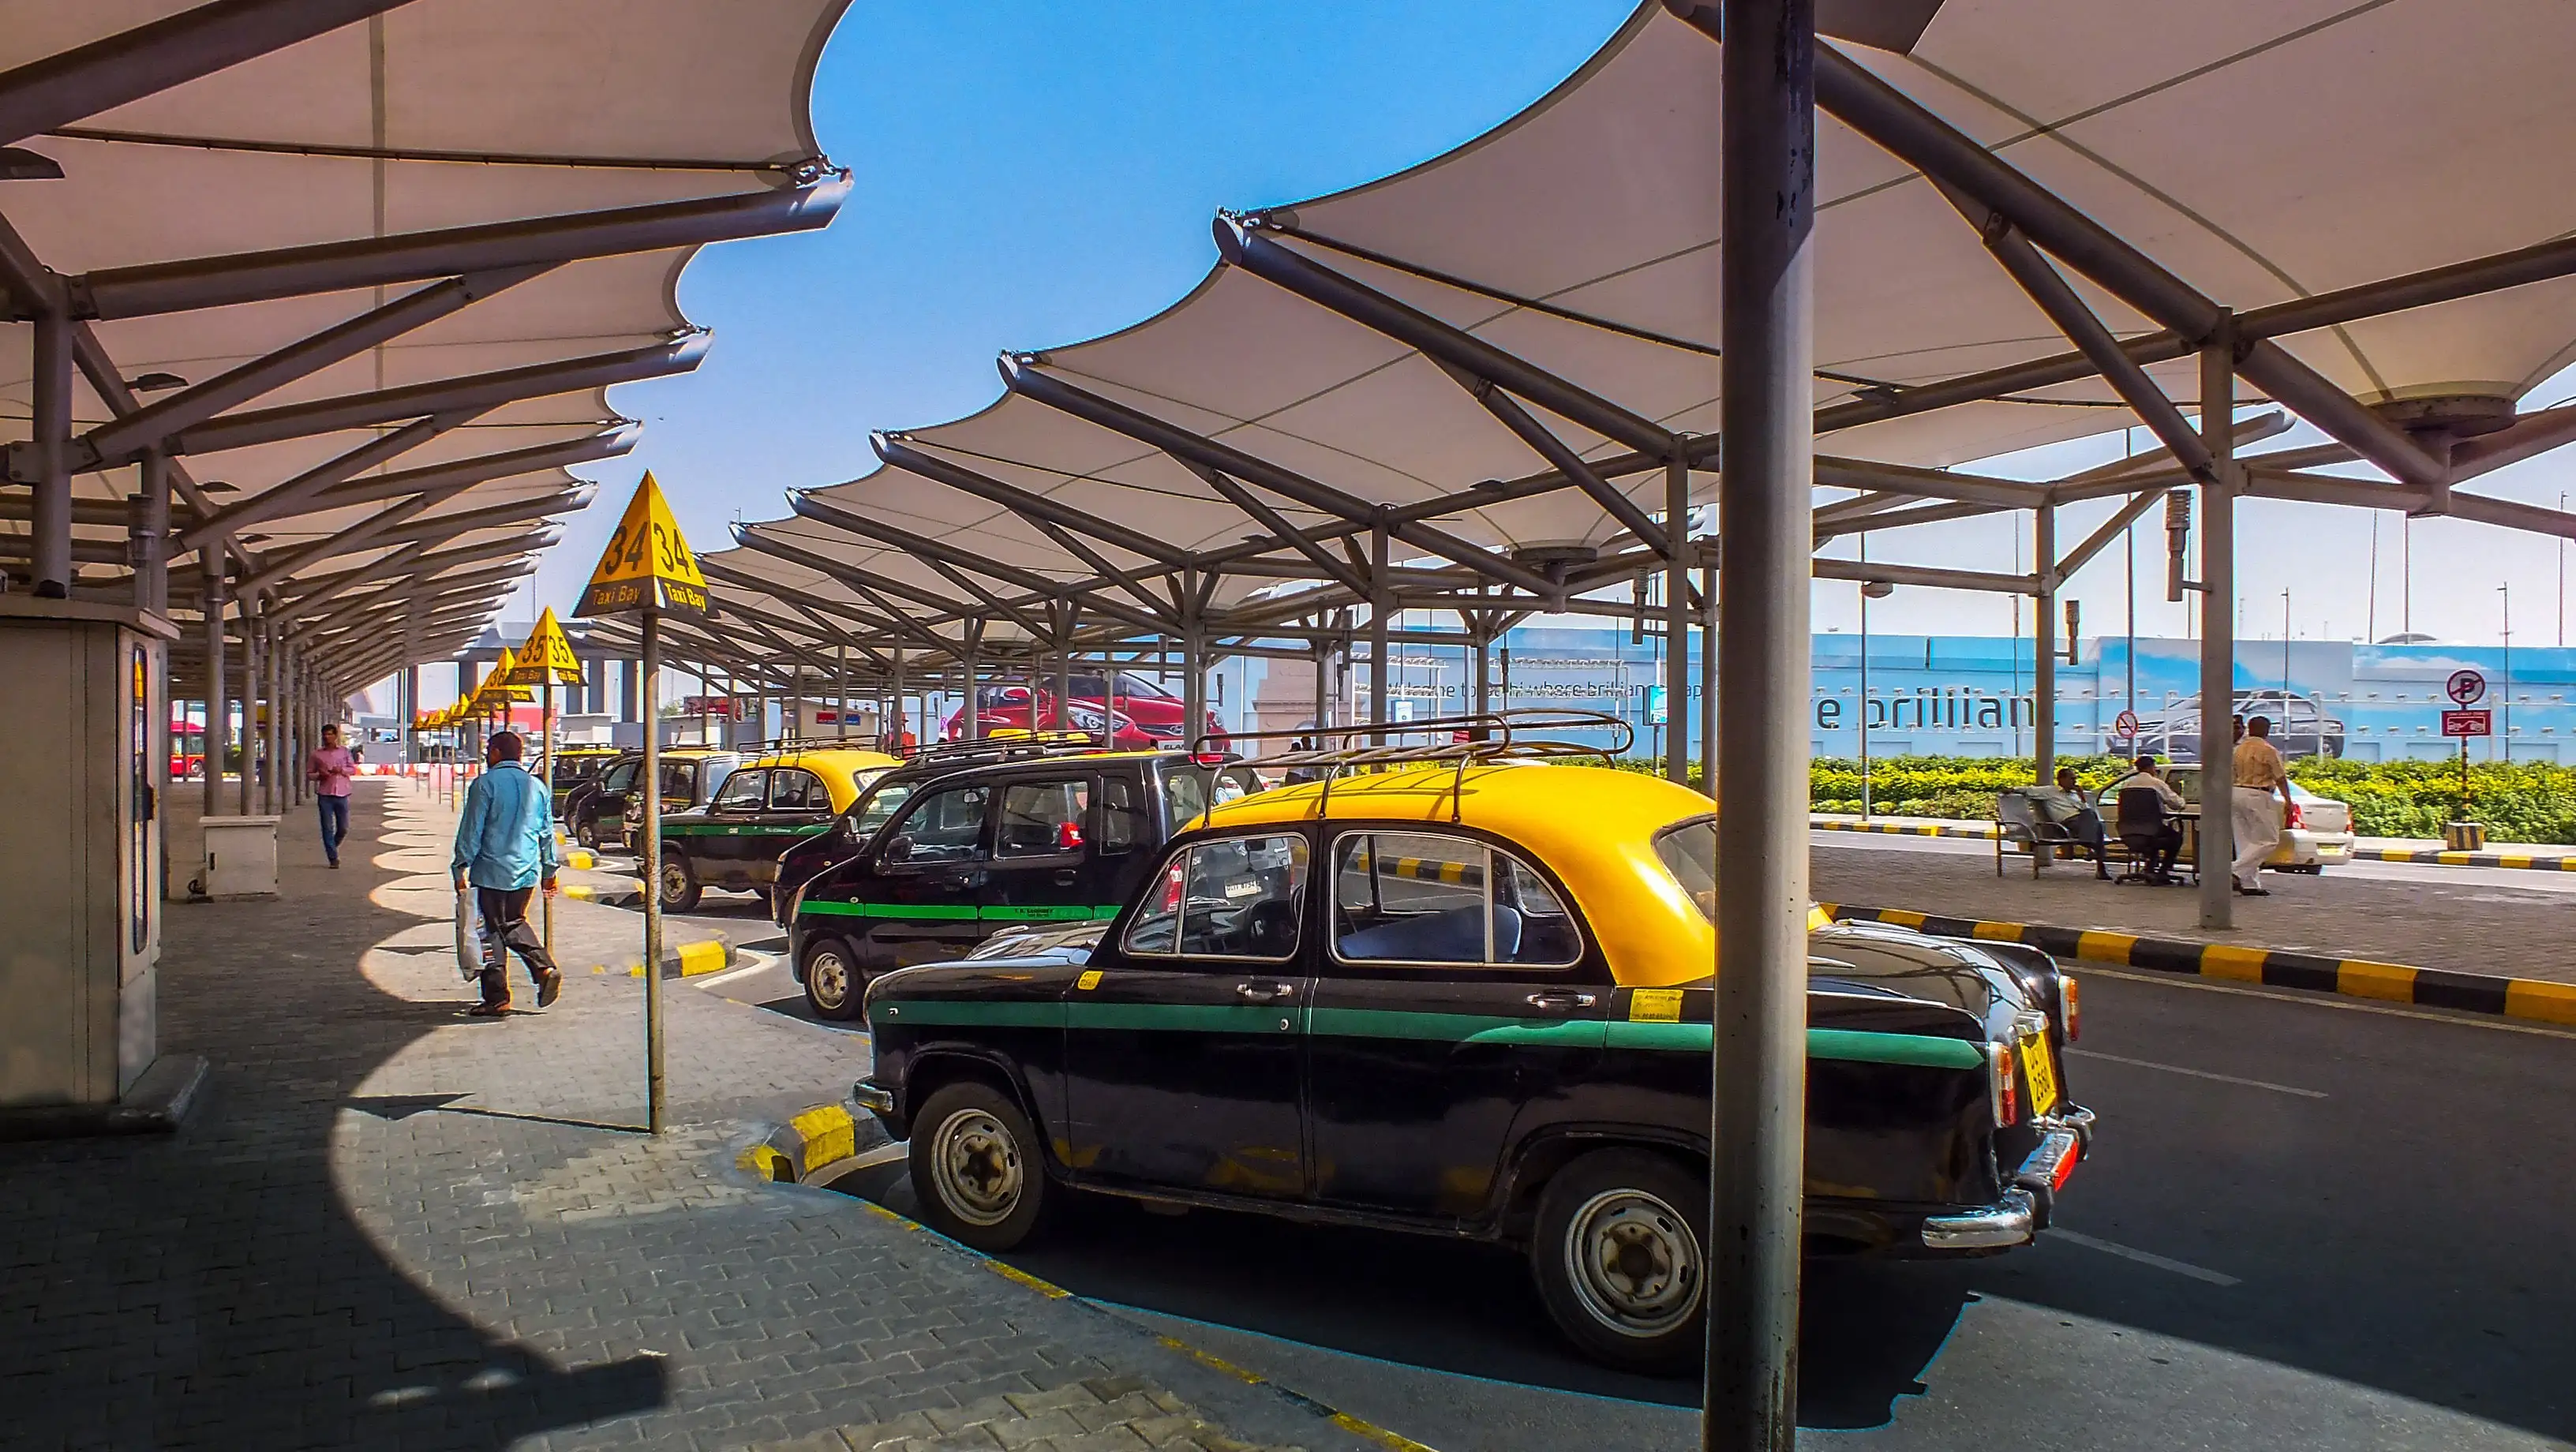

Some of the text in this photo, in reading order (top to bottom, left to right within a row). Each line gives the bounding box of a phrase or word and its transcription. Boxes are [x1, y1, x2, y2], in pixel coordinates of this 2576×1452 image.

[605, 521, 648, 575] 34
[653, 522, 691, 577] 34
[593, 586, 641, 606] Taxi Bay
[664, 582, 707, 612] Taxi Bay
[522, 635, 548, 664] 35
[549, 635, 570, 664] 35
